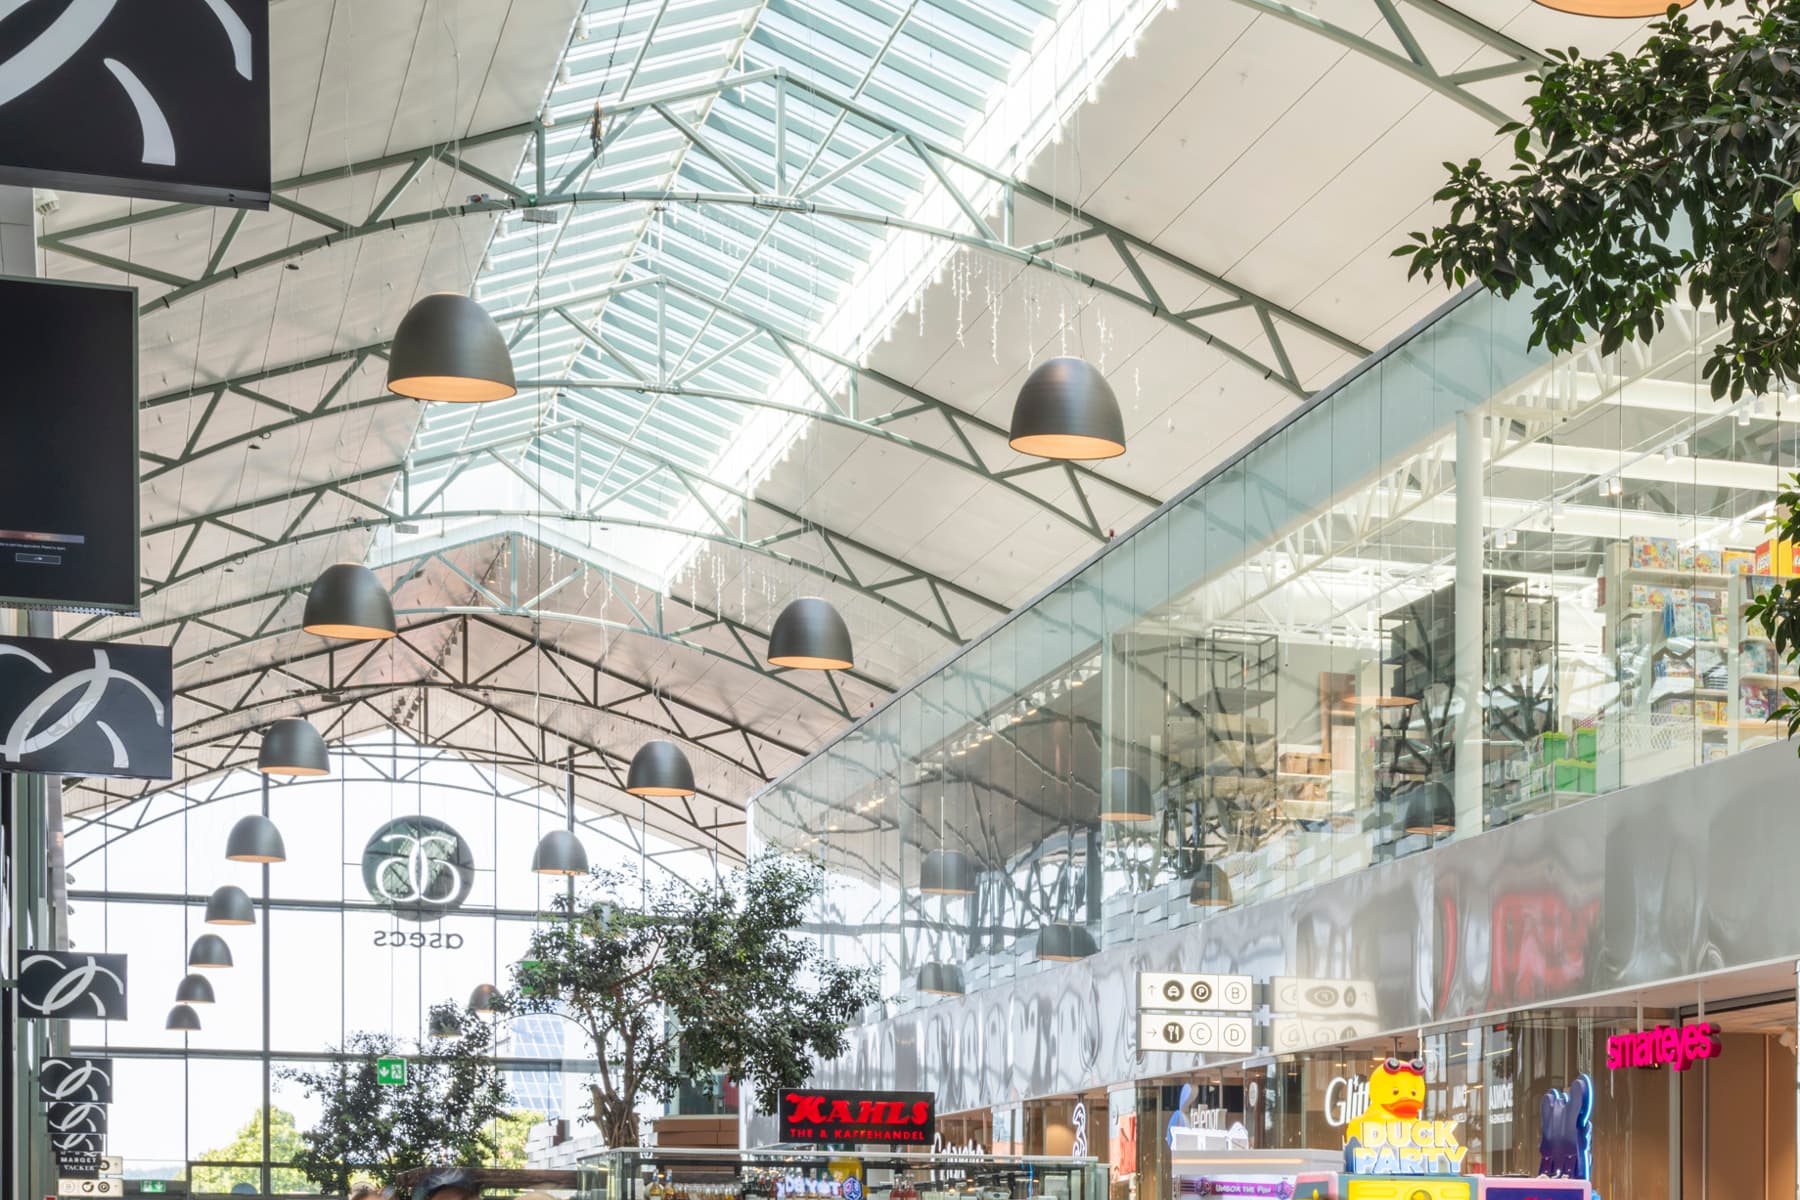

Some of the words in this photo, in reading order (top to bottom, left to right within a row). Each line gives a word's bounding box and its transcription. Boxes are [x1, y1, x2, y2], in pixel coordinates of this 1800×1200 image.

[1606, 1022, 1712, 1072] smarteyes
[785, 1092, 930, 1125] KAHLS
[790, 1128, 813, 1138] THE
[834, 1129, 925, 1140] KAFFEHANDEL
[1362, 1119, 1460, 1148] DUCK
[1353, 1147, 1469, 1175] PARTY
